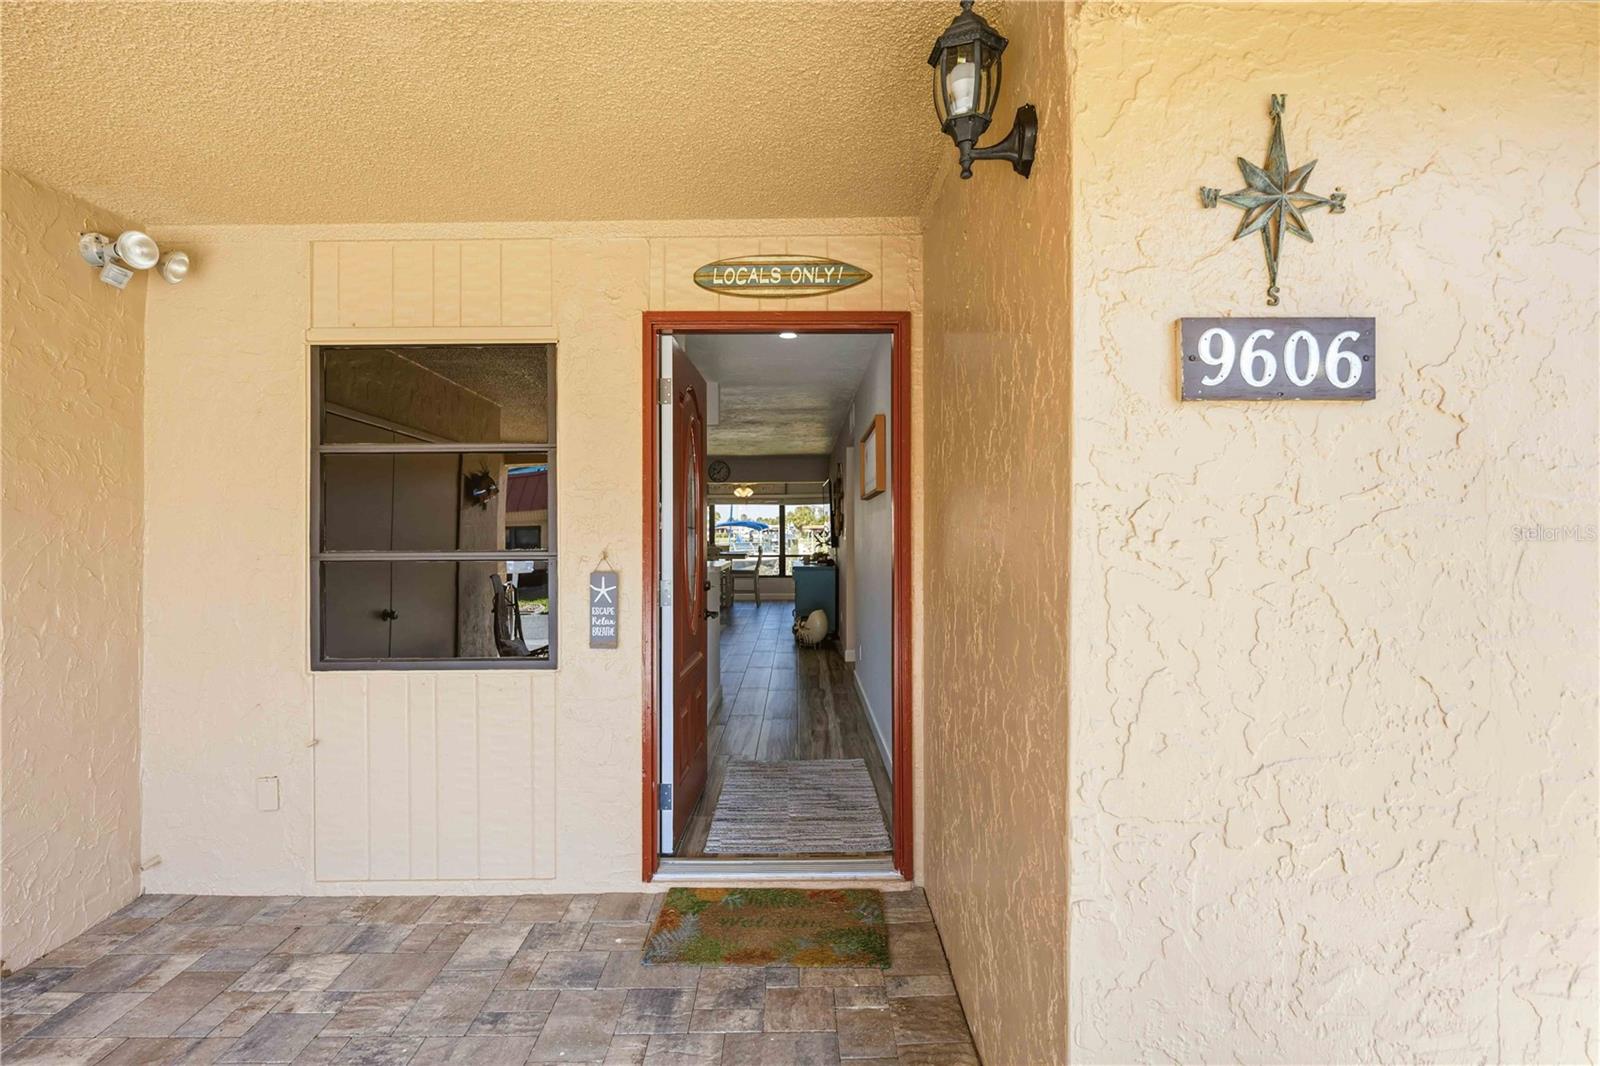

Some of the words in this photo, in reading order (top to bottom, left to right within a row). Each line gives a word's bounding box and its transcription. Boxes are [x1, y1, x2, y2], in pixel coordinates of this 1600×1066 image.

[1271, 94, 1288, 114] N
[713, 266, 781, 285] LOCALS
[790, 266, 844, 285] ONLY!
[1266, 286, 1280, 306] S
[1197, 327, 1363, 389] 9606
[592, 607, 615, 615] ESCAPE
[592, 626, 615, 636] BREATHE
